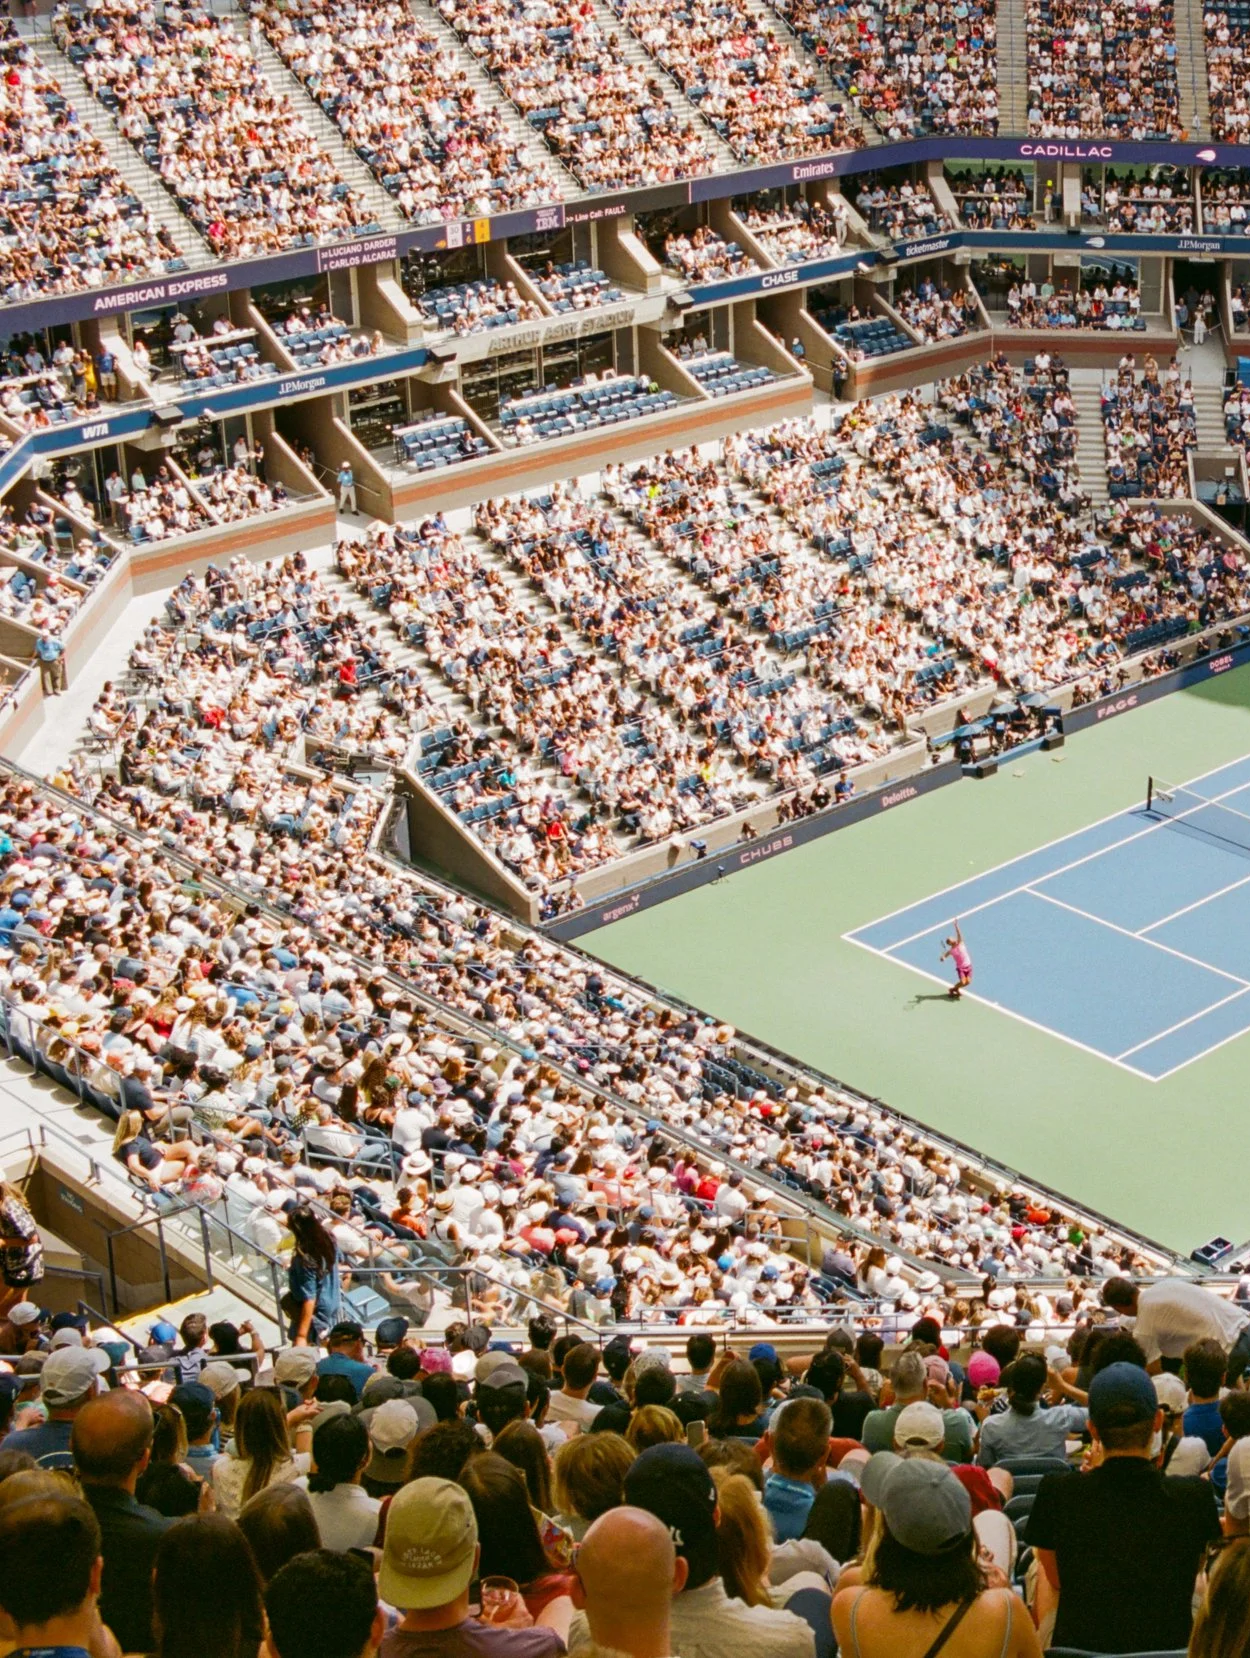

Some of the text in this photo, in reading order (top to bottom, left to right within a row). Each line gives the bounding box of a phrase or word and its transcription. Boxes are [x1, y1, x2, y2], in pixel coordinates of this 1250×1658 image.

[1020, 145, 1113, 158] CADILLAC
[793, 161, 834, 180] Emirates
[465, 223, 471, 232] 2
[536, 215, 559, 231] IBM
[328, 243, 362, 258] LUCIANO
[364, 237, 397, 251] DARDERI
[905, 239, 949, 257] ticketmaster
[1177, 240, 1221, 251] J.P.Morgan
[329, 256, 360, 269] CARLOS
[362, 249, 397, 263] ALCARAZ
[762, 270, 799, 288] CHASE
[94, 273, 228, 311] AMERICAN EXPRESS
[278, 376, 326, 395] J.P.Morgan
[82, 423, 109, 440] WTA
[1209, 655, 1234, 670] DOBEL
[739, 835, 793, 864] CHUBB
